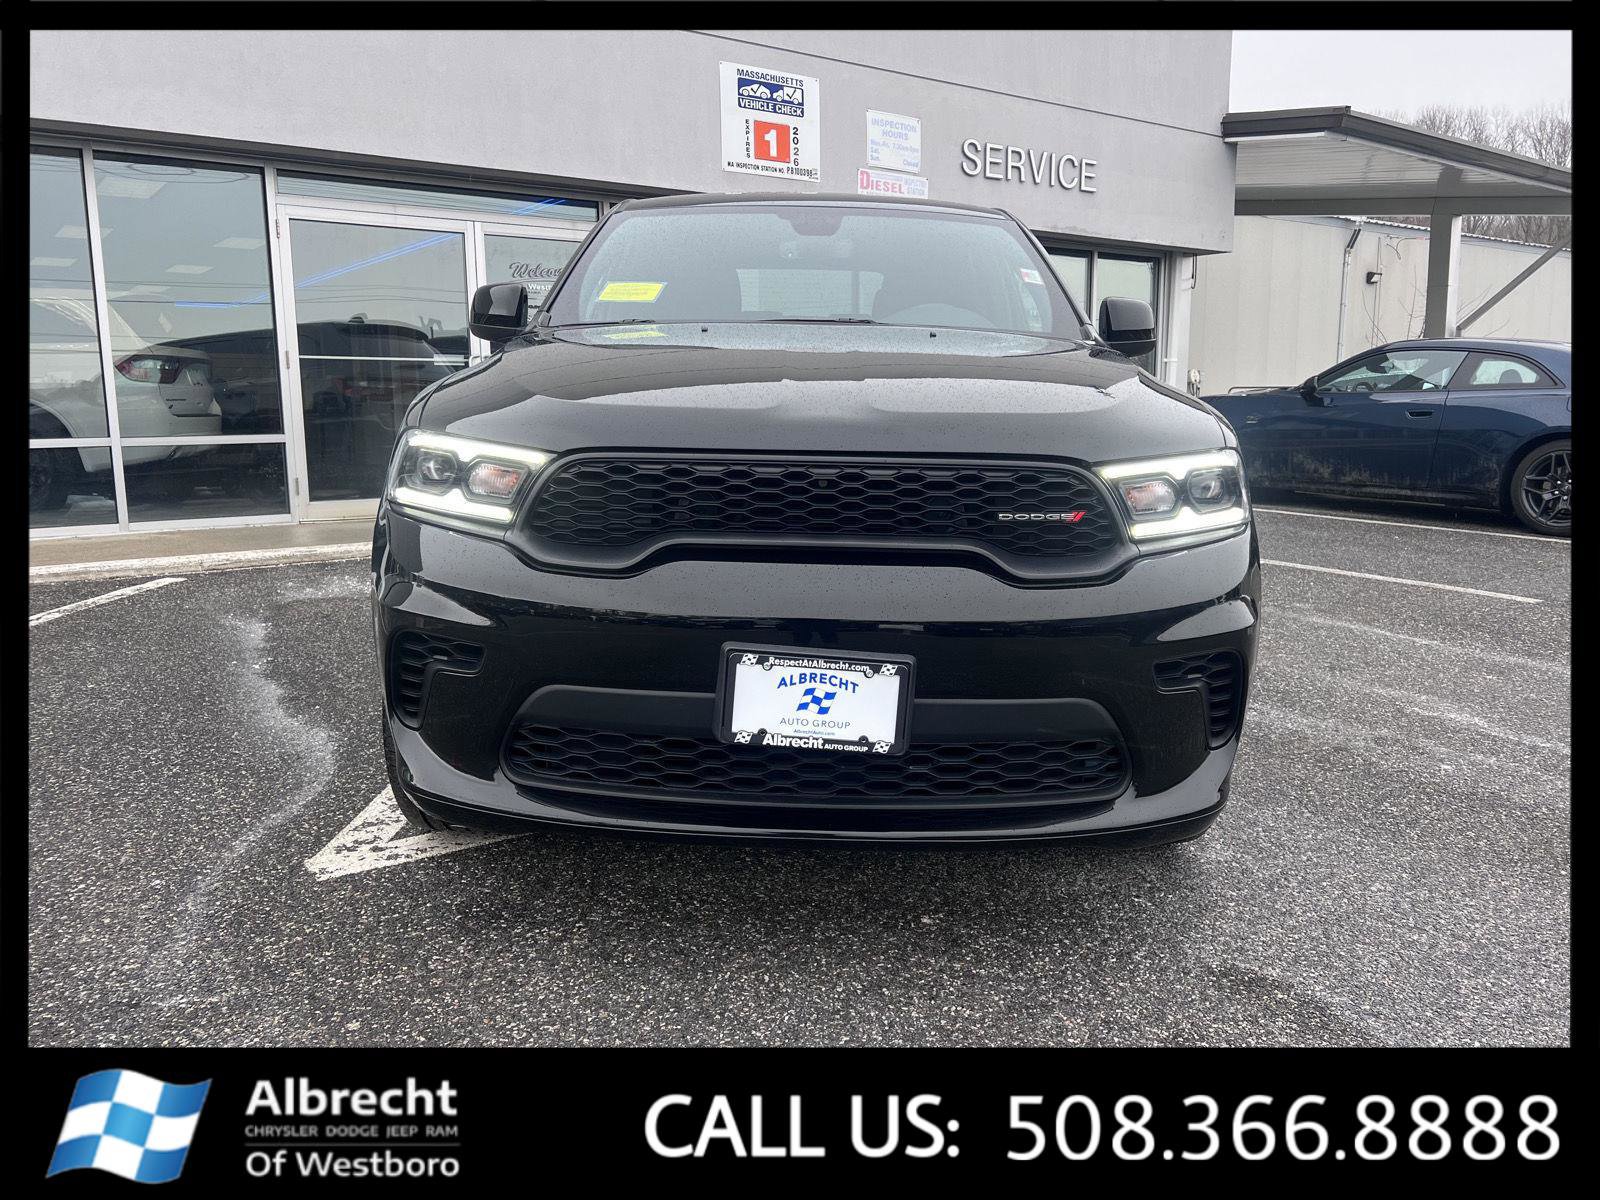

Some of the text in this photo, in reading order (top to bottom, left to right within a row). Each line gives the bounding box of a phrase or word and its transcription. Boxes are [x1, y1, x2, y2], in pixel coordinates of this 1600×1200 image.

[736, 68, 804, 87] MASSACHUSETTS
[740, 98, 803, 117] VEHICLE CHECK
[871, 117, 917, 133] INSPECTION
[764, 129, 777, 157] 1
[882, 129, 909, 141] HOURS
[736, 162, 760, 171] INSPECTION
[761, 165, 778, 173] STATION
[961, 138, 1098, 193] SERVICE
[859, 170, 905, 194] DIESEL
[998, 513, 1076, 521] DODGE
[769, 656, 870, 672] RespectAtAlbrecht.com
[777, 672, 859, 694] ALBRECHT
[779, 717, 851, 729] AUTO GROUP
[762, 733, 869, 753] Albrecht AUTO GROUP
